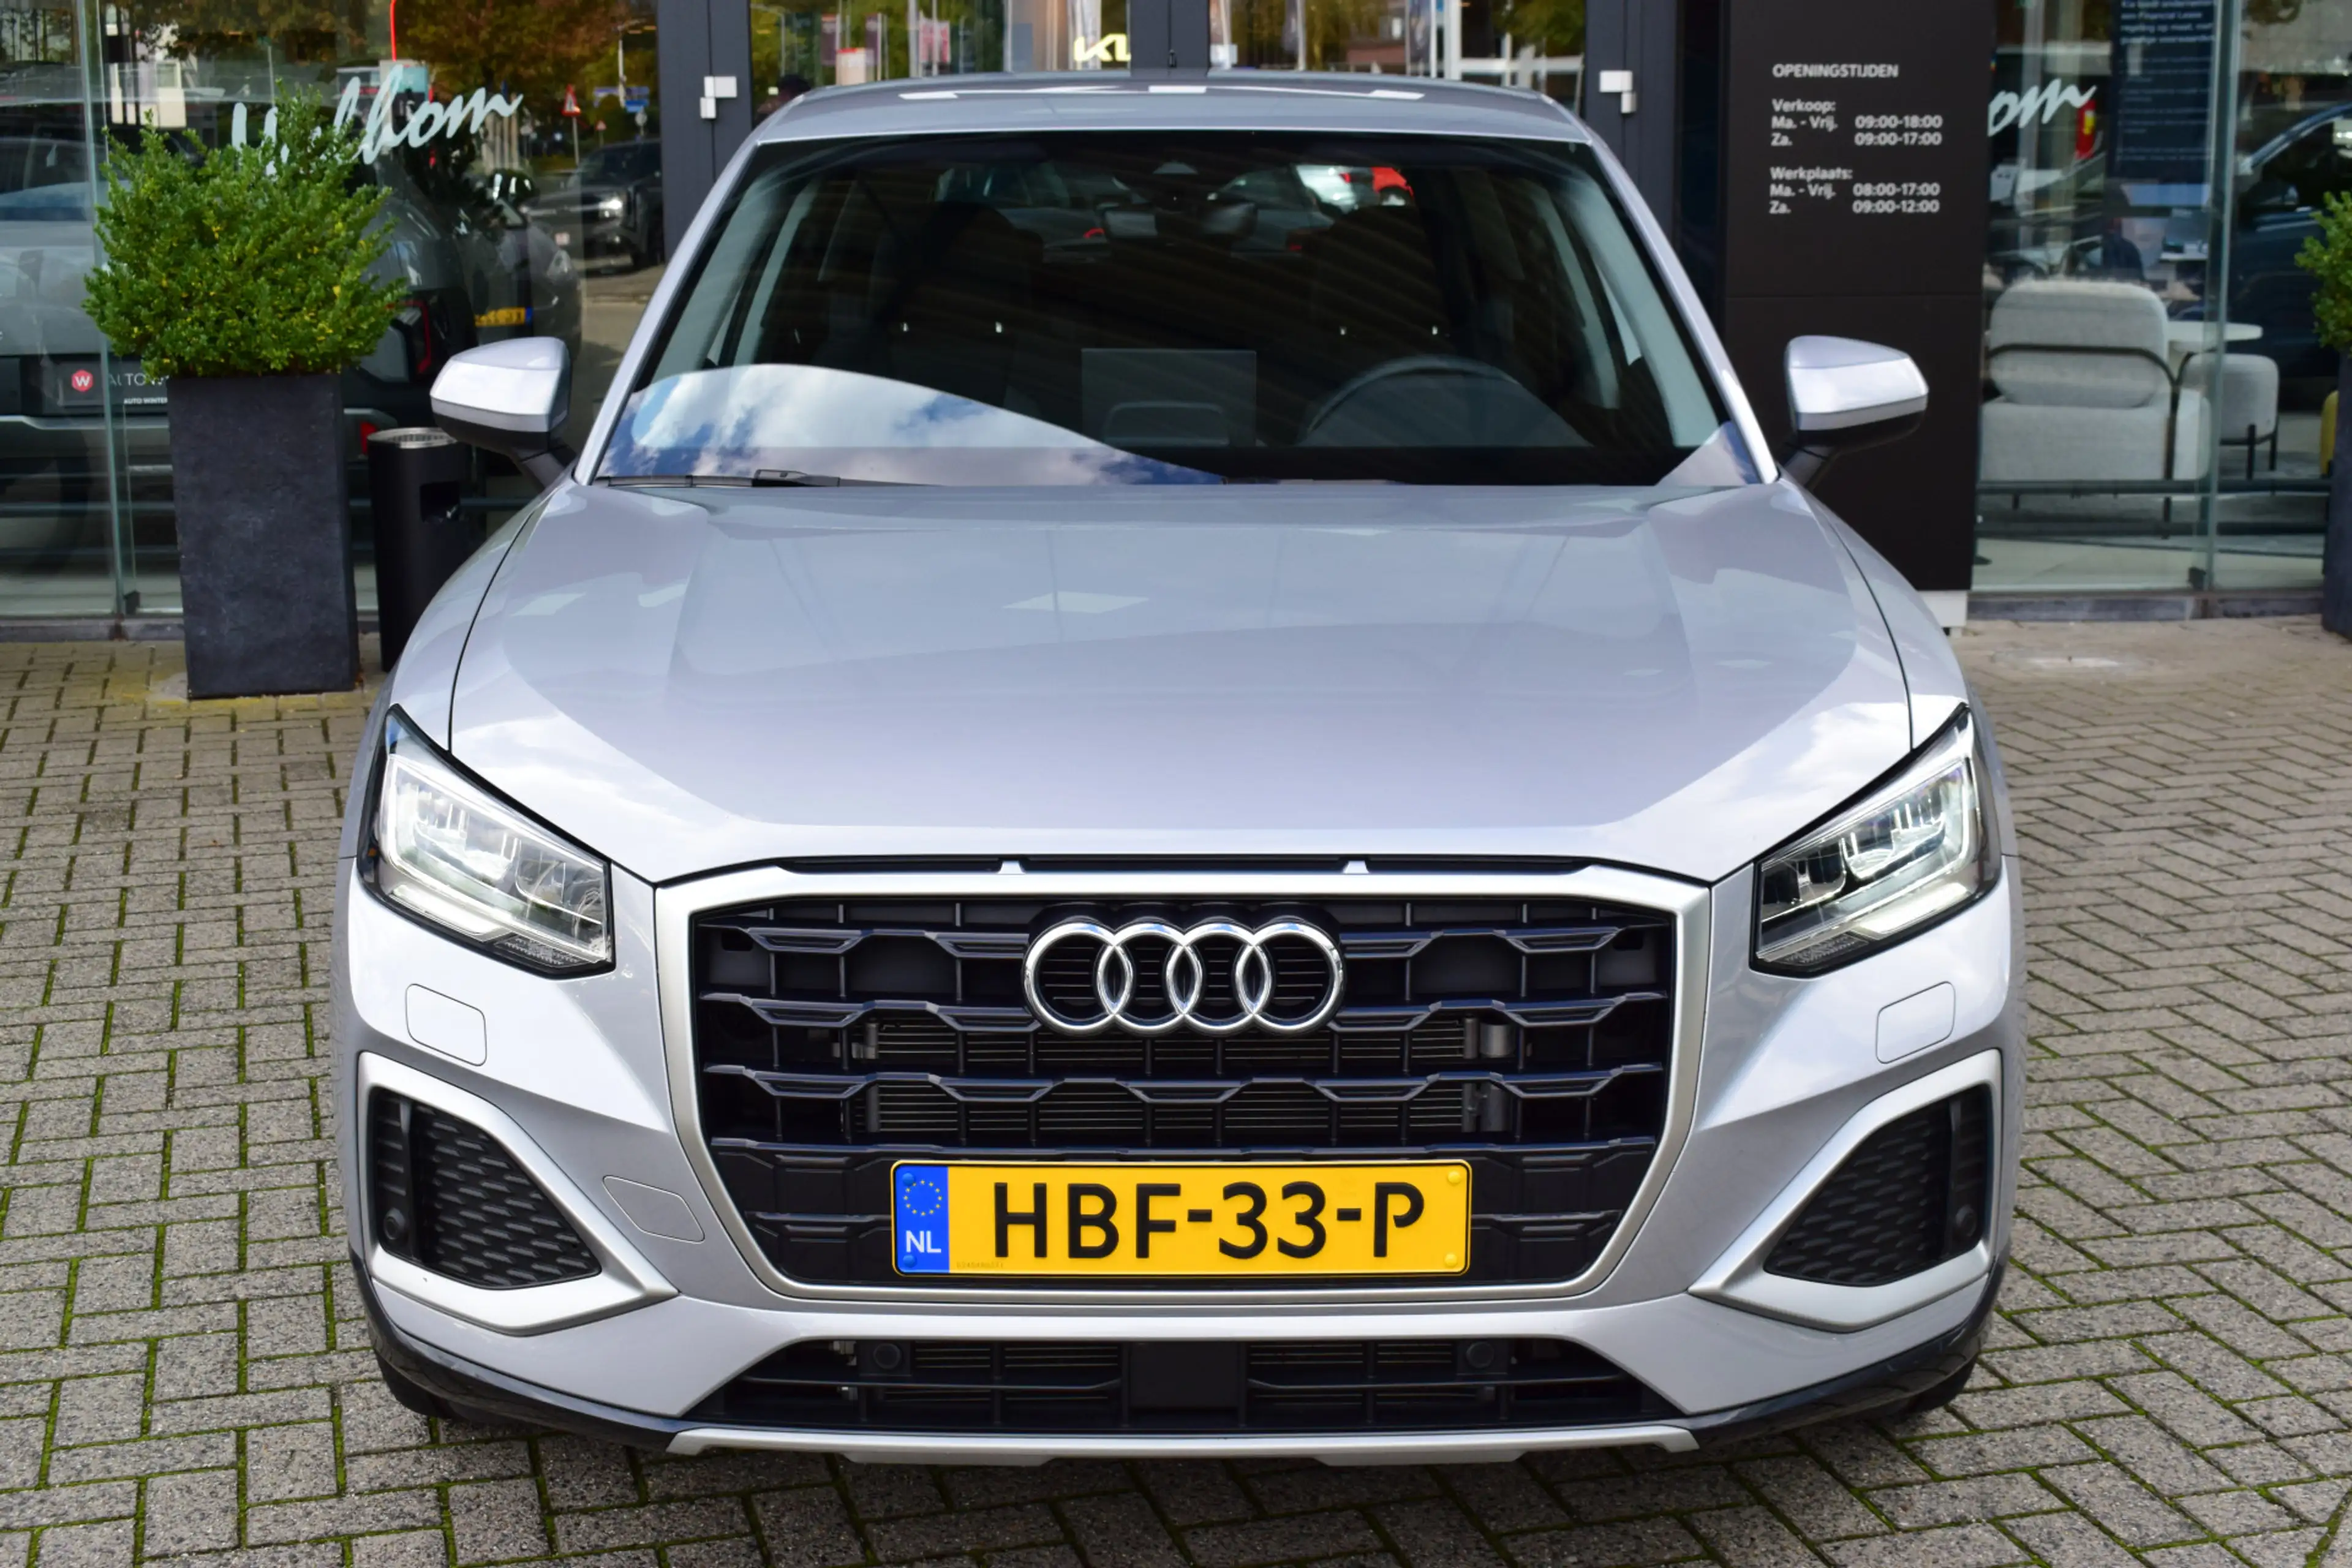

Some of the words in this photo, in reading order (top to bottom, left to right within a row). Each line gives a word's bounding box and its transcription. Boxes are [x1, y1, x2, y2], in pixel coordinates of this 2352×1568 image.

[1772, 63, 1899, 78] OPENINGSTIJDEN
[1771, 99, 1836, 114] Verkoop:
[1771, 115, 1798, 129] Ma.
[1809, 115, 1838, 132] Vrij.
[1854, 115, 1943, 129] 09:00-18:00
[1771, 132, 1793, 146] Za.
[1854, 132, 1943, 146] 09:00-17:00
[1770, 166, 1853, 182] Werkplaats:
[1770, 183, 1796, 197] Ma.
[1807, 183, 1836, 200] Vrij.
[1852, 183, 1940, 197] 08:00-17:00
[1769, 200, 1792, 214] Za.
[1852, 200, 1940, 214] 09:00-12:00
[993, 1181, 1425, 1259] HBF-33-P
[905, 1230, 943, 1254] NL
